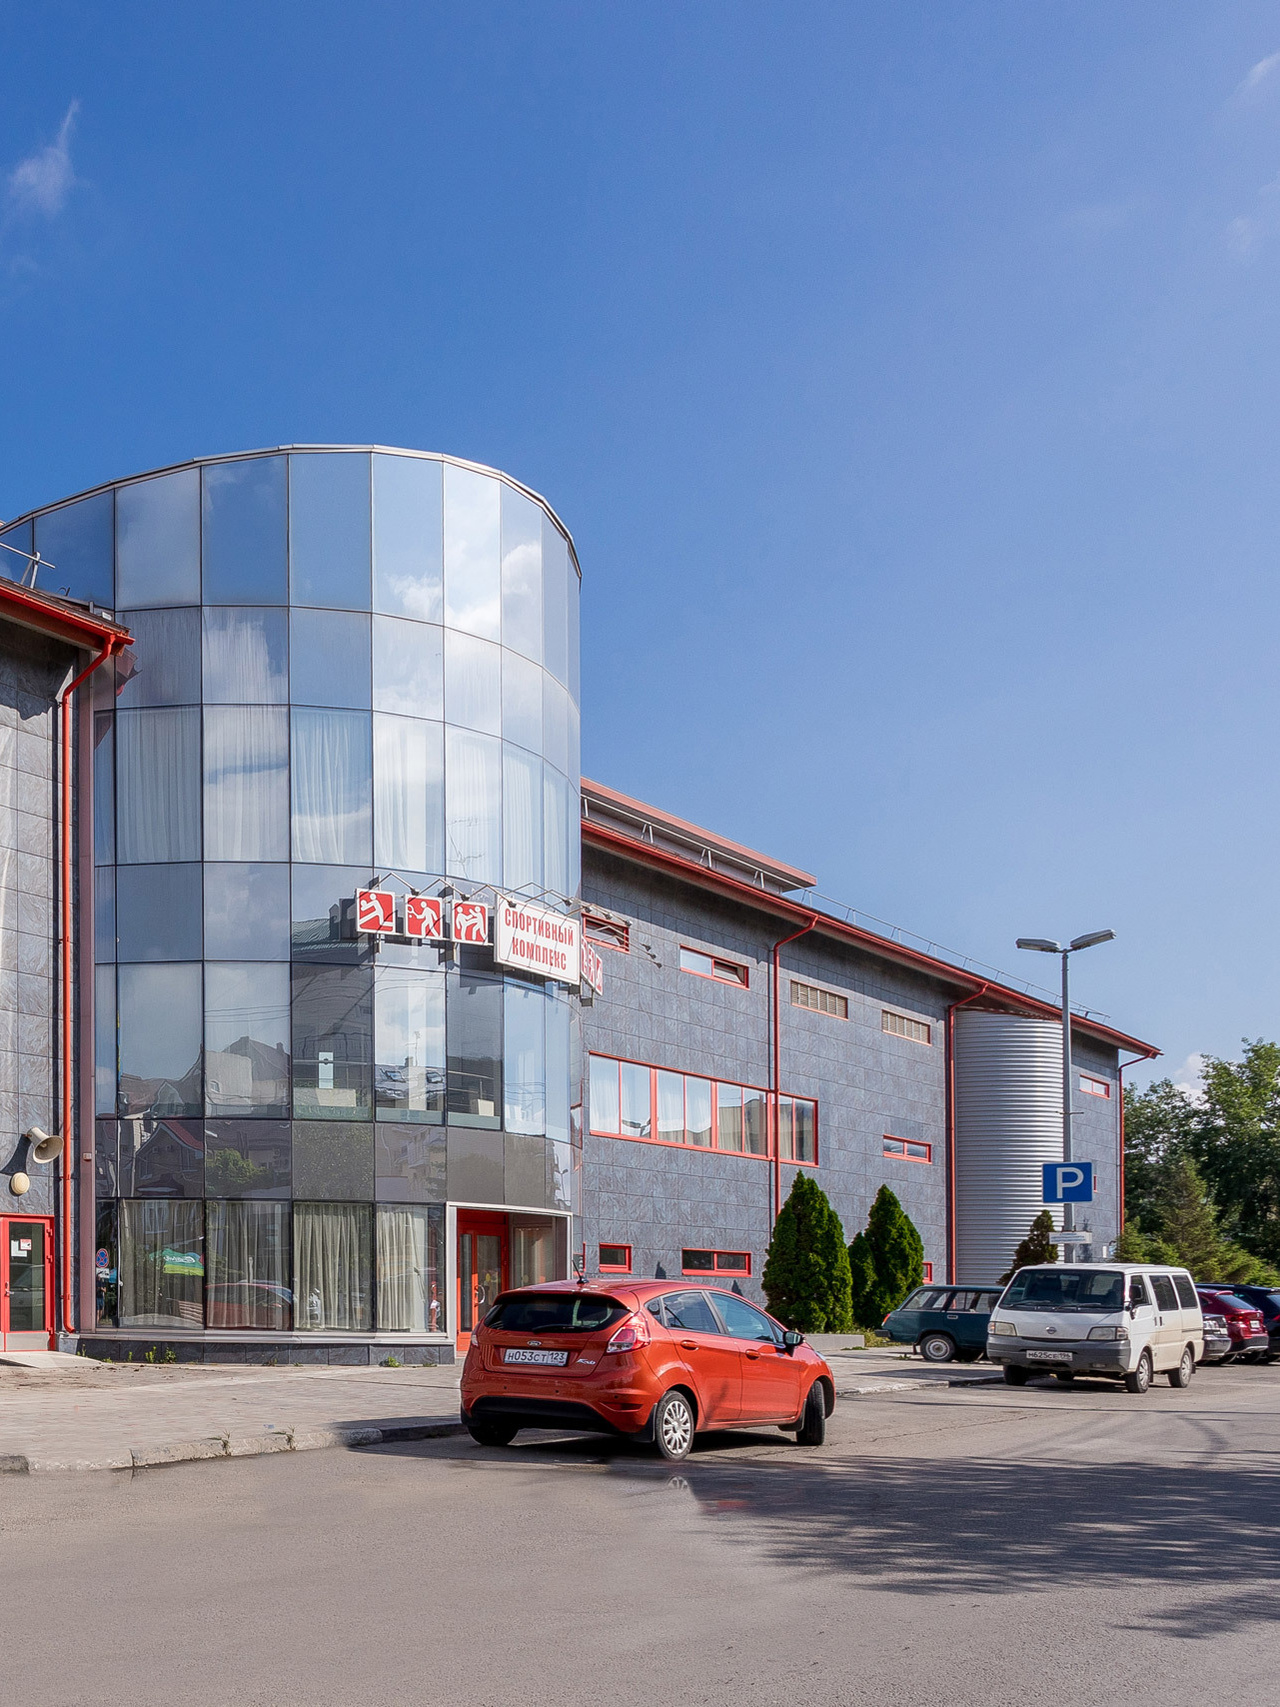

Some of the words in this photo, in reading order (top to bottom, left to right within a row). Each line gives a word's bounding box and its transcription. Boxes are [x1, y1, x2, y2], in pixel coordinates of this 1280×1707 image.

[504, 908, 574, 946] СПОРТИВНЫЙ
[512, 936, 567, 970] КОМПЛЕКС
[1056, 1167, 1084, 1199] P
